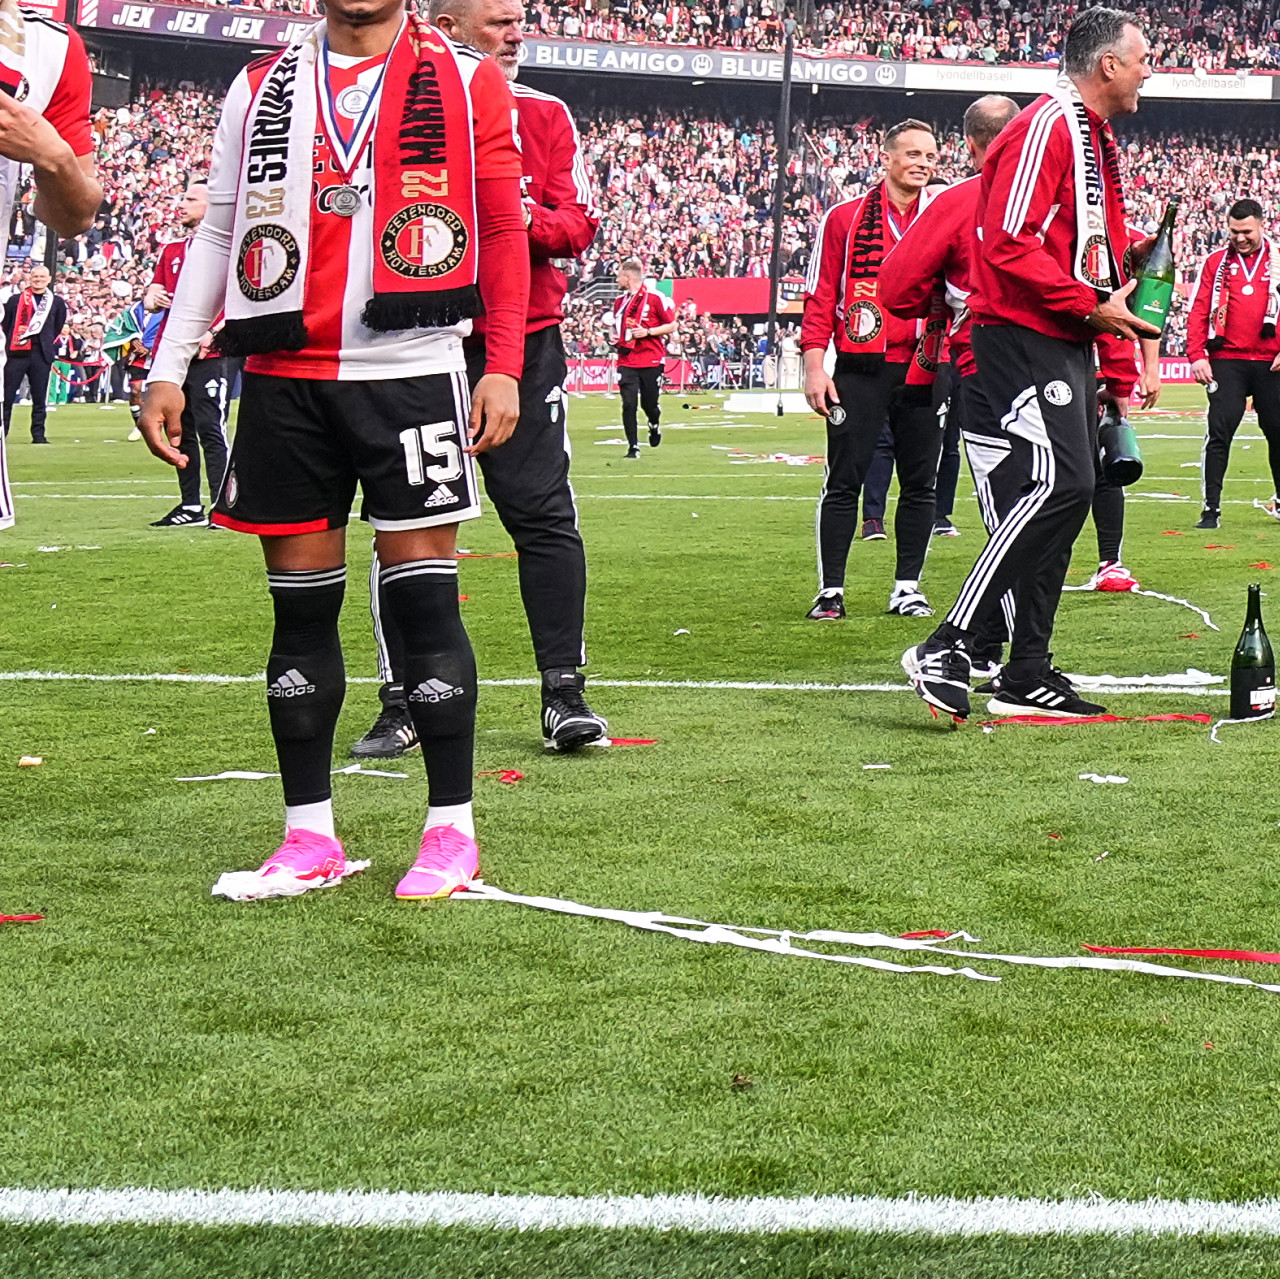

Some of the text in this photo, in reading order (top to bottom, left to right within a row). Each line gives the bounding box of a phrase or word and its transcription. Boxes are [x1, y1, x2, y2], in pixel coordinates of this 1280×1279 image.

[112, 5, 312, 43] JEX JEX JEX JE
[536, 45, 685, 73] BLUE AMIGO
[721, 52, 868, 83] BLUE AMIGO
[936, 69, 1013, 82] lyondellbasell
[1172, 77, 1246, 90] lyondellbasell
[400, 169, 449, 198] 22
[246, 186, 286, 219] 23
[387, 203, 462, 238] FEYENOORD
[385, 247, 463, 276] ROTTERDAM
[853, 281, 878, 298] 22
[399, 420, 463, 486] 15
[424, 495, 459, 508] adidas
[267, 683, 316, 698] adidas
[409, 685, 464, 704] adidas
